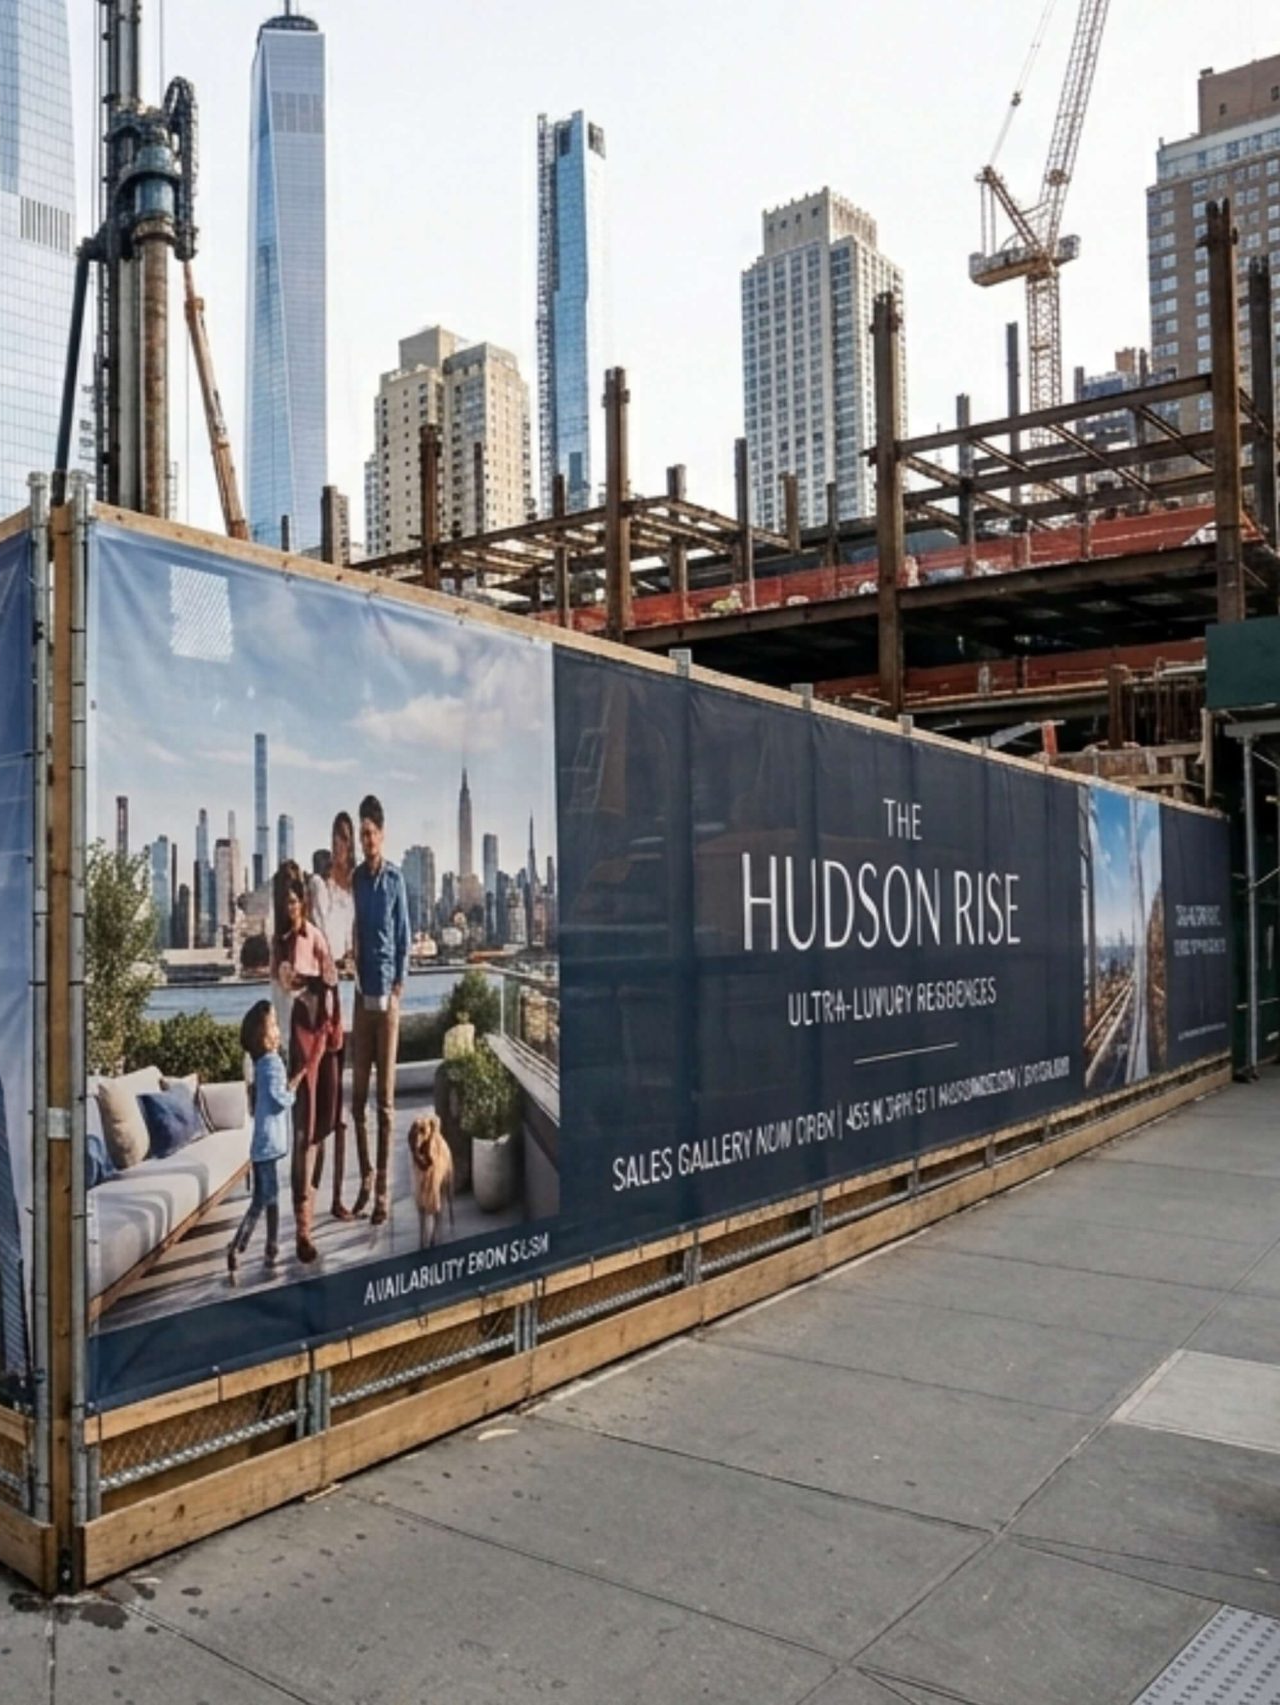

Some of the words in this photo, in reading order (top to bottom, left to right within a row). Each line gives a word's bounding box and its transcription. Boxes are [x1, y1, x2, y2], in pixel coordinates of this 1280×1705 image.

[883, 797, 923, 840] THE
[741, 852, 941, 952] HUDSON
[953, 870, 1022, 946] RISE
[612, 1147, 673, 1192] SALES
[677, 1128, 753, 1177] GALLERY
[363, 1256, 466, 1307] AVAILABILITY
